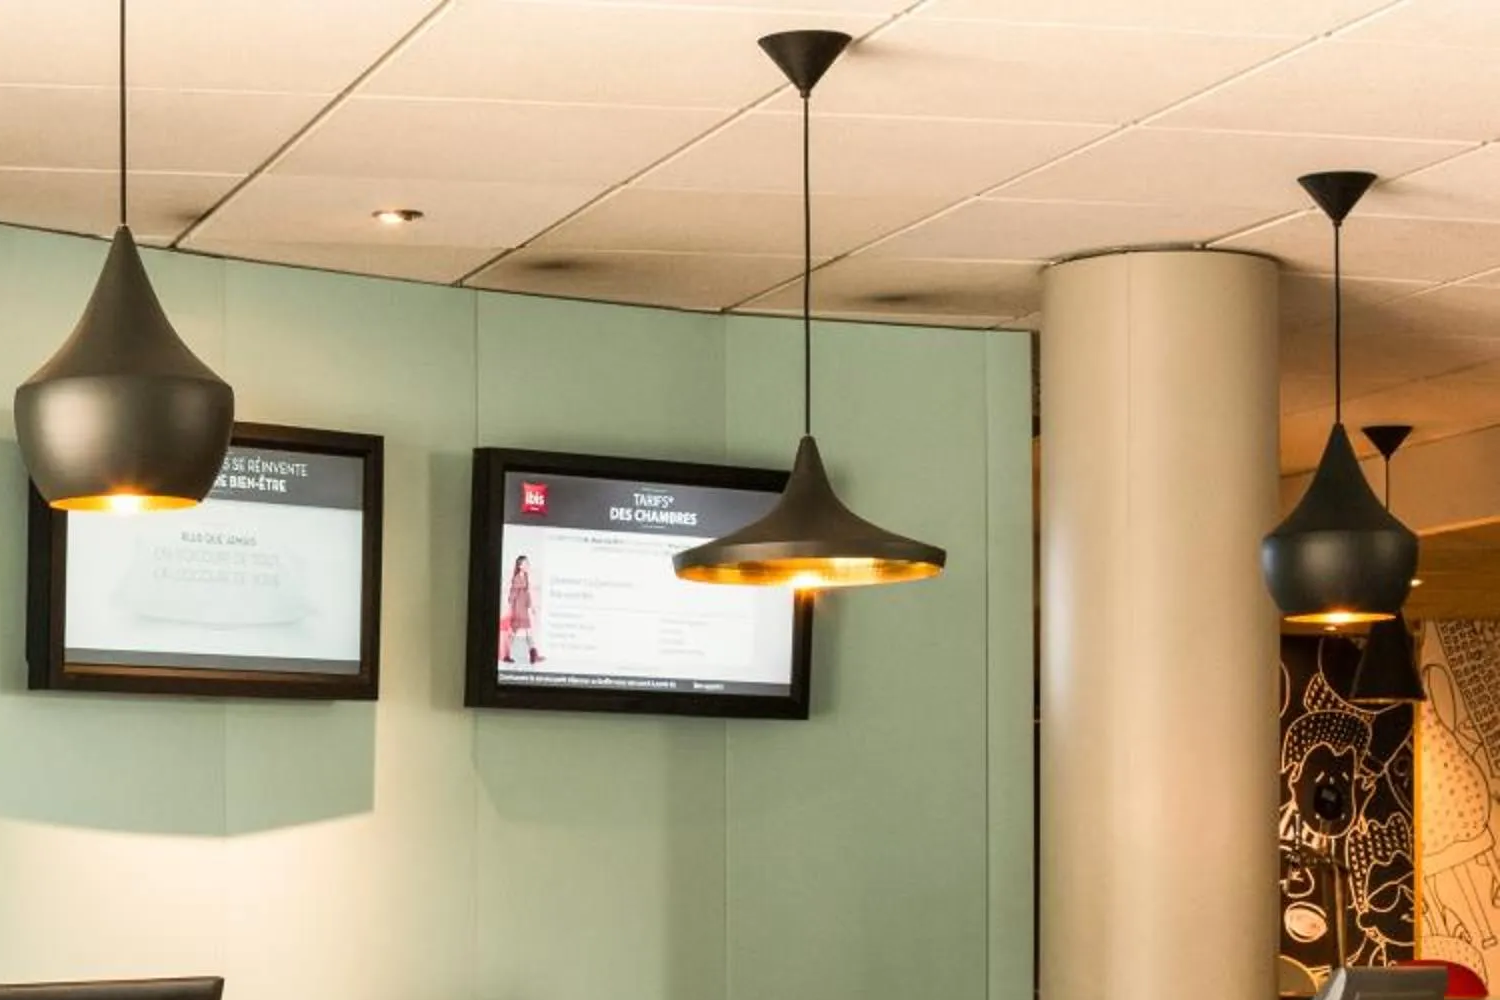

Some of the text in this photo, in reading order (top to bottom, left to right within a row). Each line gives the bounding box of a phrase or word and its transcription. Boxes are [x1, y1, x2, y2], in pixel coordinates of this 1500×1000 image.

[229, 474, 287, 492] BIEN-ÊTRE
[525, 491, 545, 505] ibis
[610, 507, 697, 525] DES CHAMBRES
